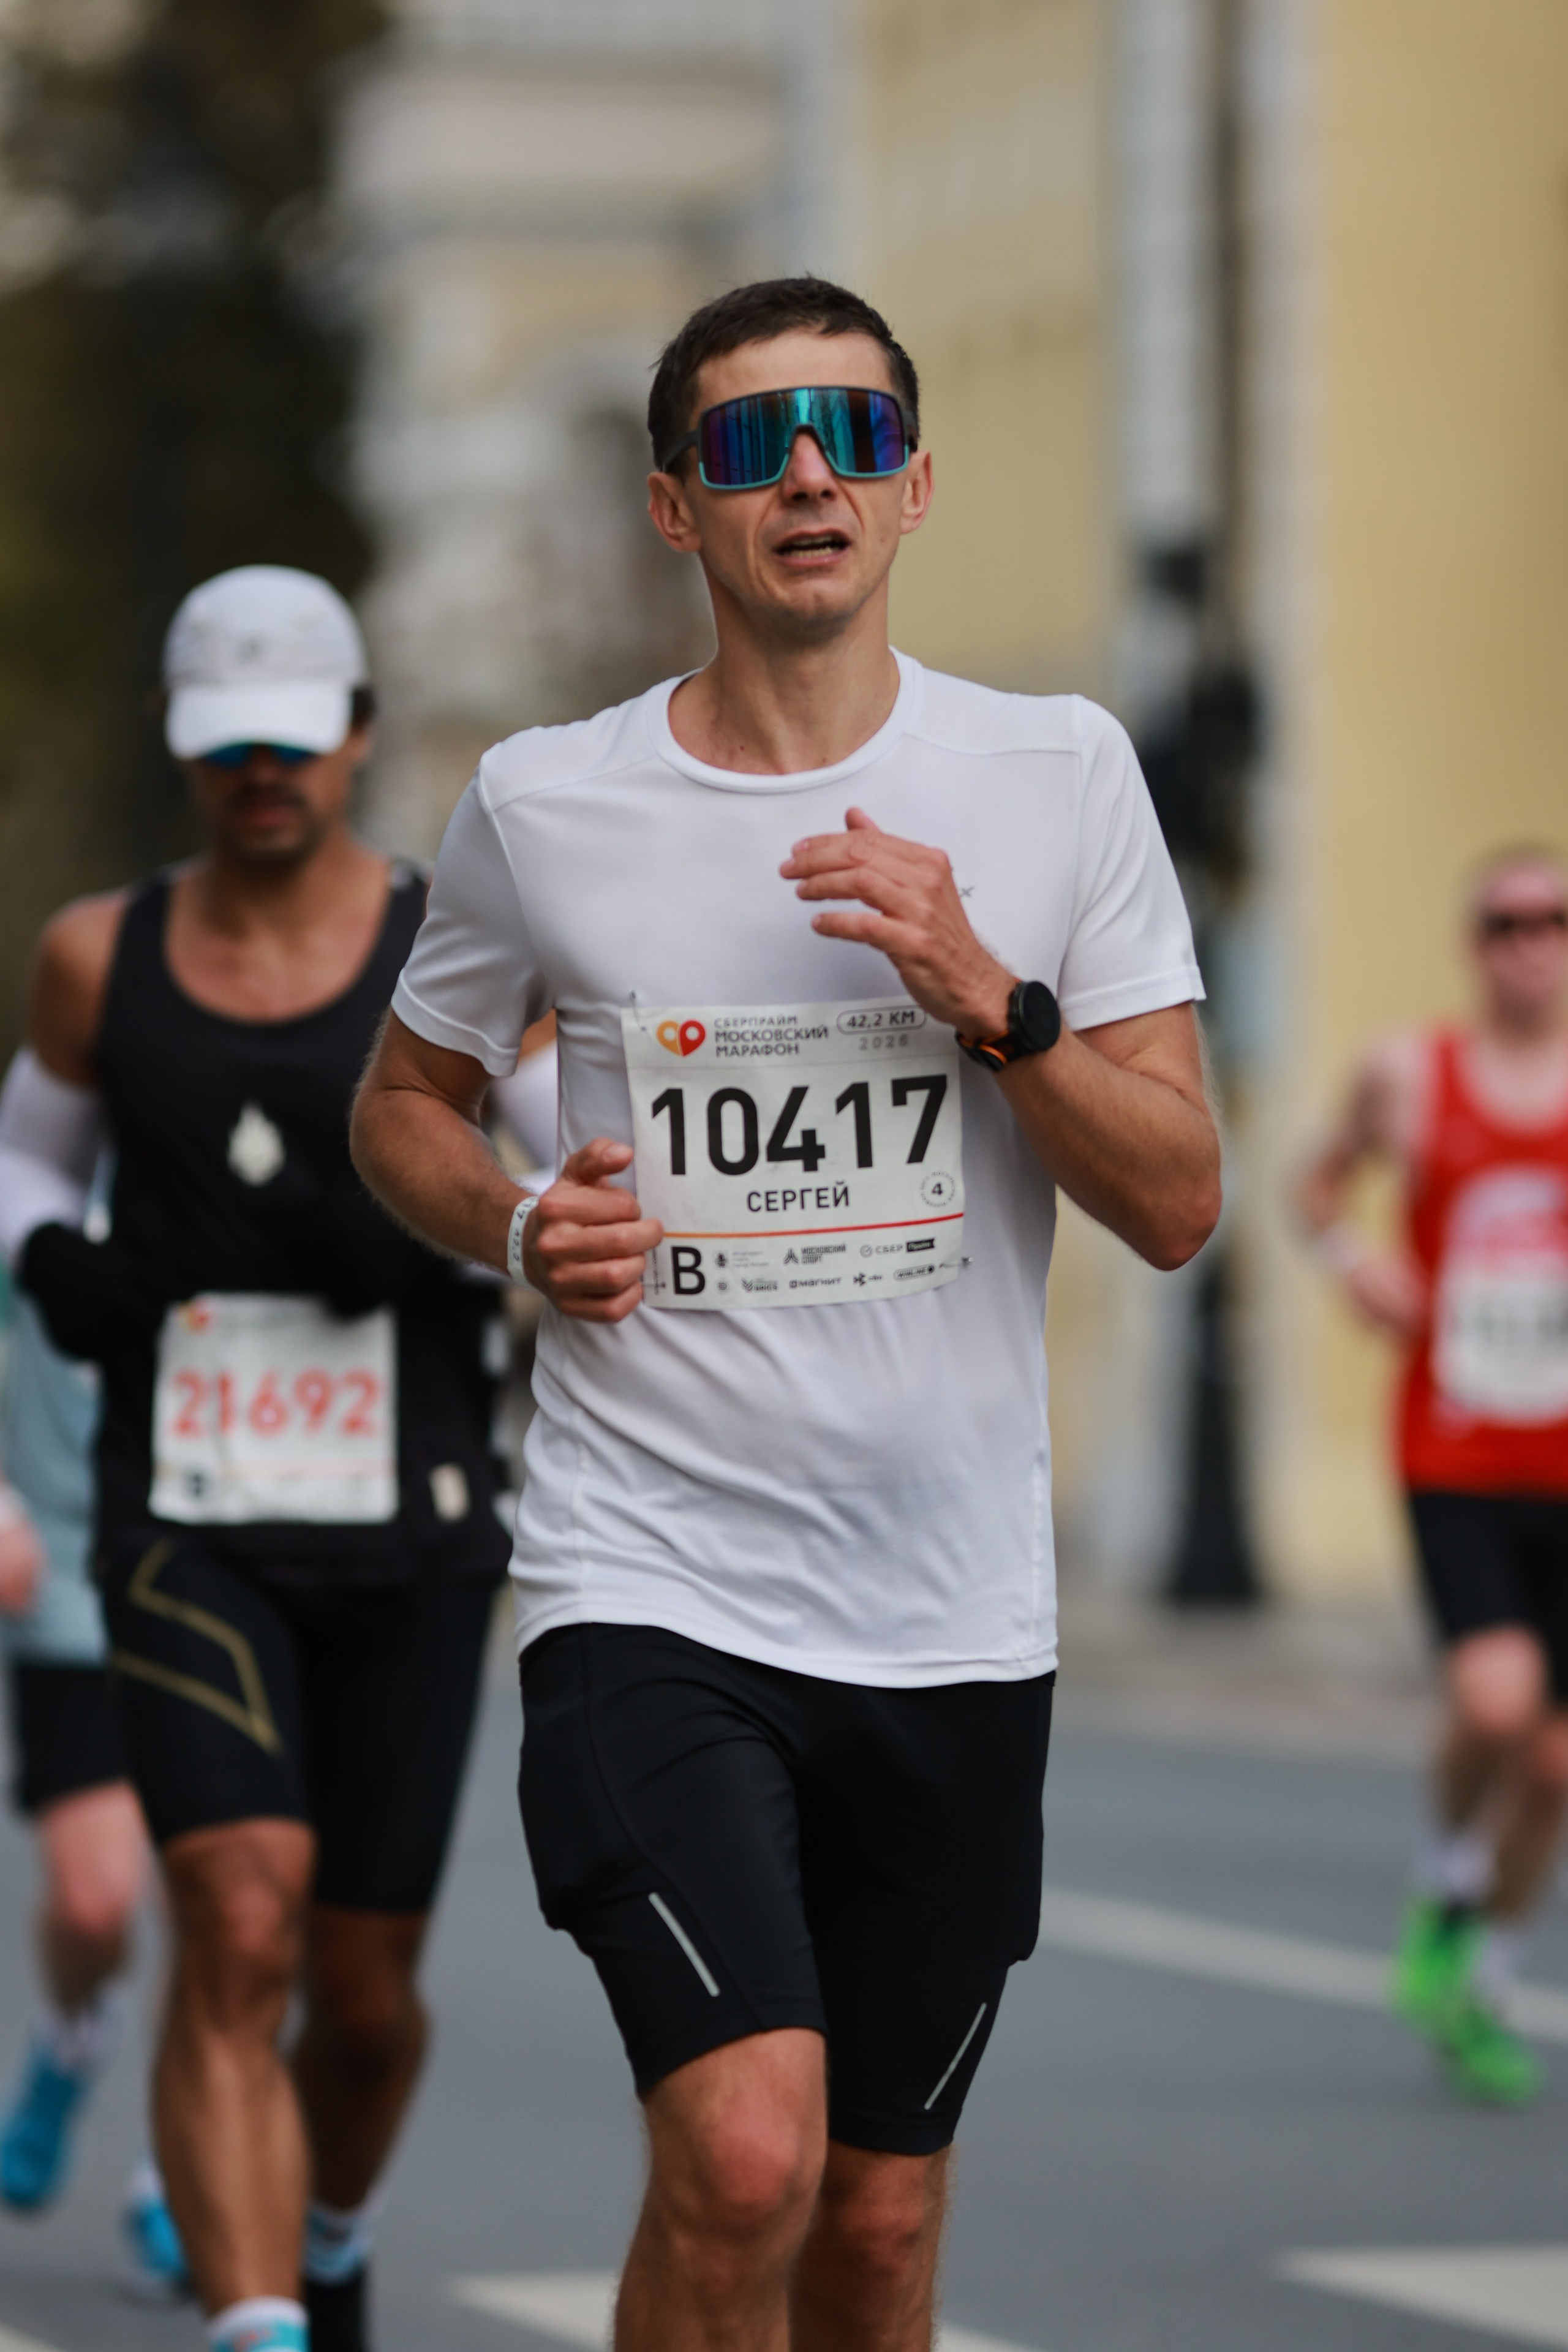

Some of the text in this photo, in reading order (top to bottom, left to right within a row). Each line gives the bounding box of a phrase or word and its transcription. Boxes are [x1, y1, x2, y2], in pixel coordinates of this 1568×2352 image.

[714, 1014, 798, 1029] СБЕРПРАЙМ
[714, 1024, 829, 1042] МОСКОВСКИЙ
[715, 1042, 800, 1058] МАРАФОН
[650, 1074, 948, 1176] 10417
[747, 1180, 850, 1213] СЕРГЕЙ
[931, 1182, 944, 1196] 4
[173, 1368, 379, 1438] 21692
